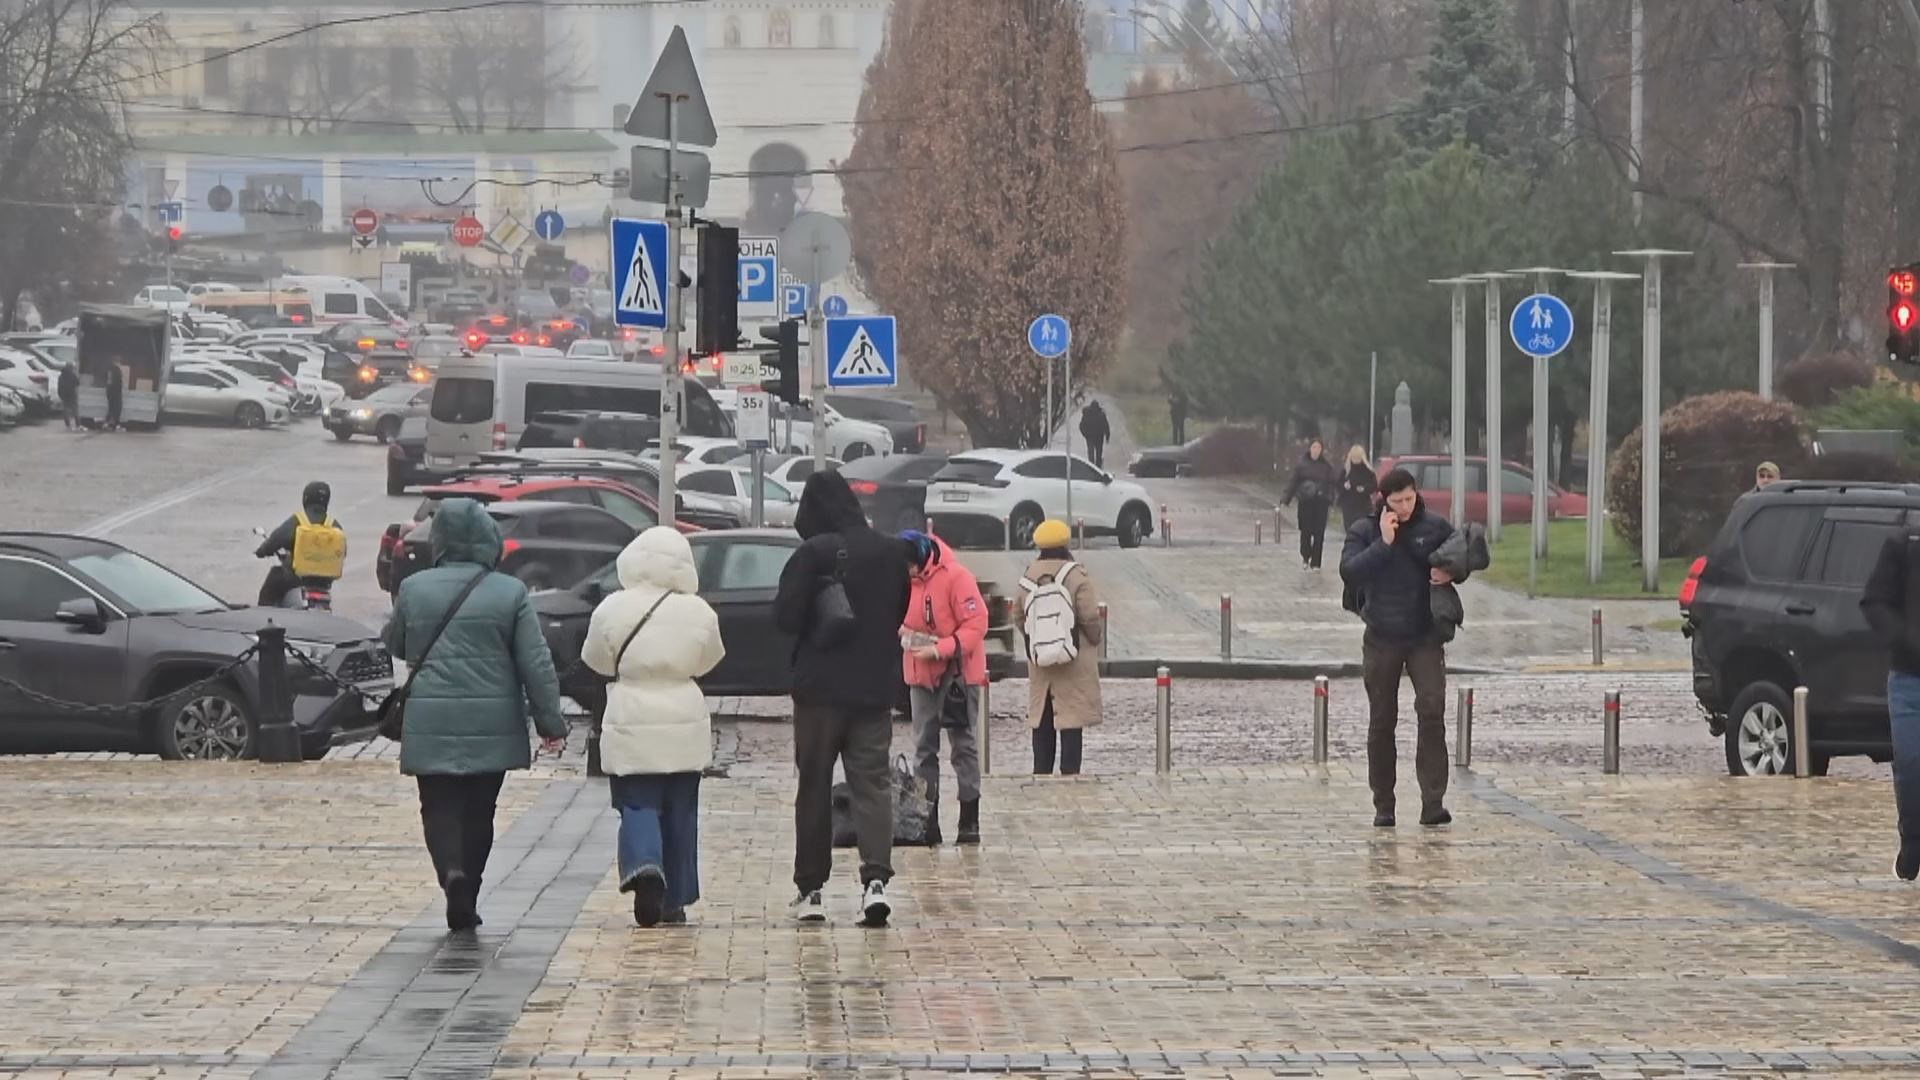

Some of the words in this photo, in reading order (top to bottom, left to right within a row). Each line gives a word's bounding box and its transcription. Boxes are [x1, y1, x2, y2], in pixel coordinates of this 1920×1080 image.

[455, 227, 481, 238] STOP
[739, 242, 776, 257] ОНА
[741, 263, 766, 300] P
[785, 289, 800, 312] P
[741, 364, 755, 375] 25
